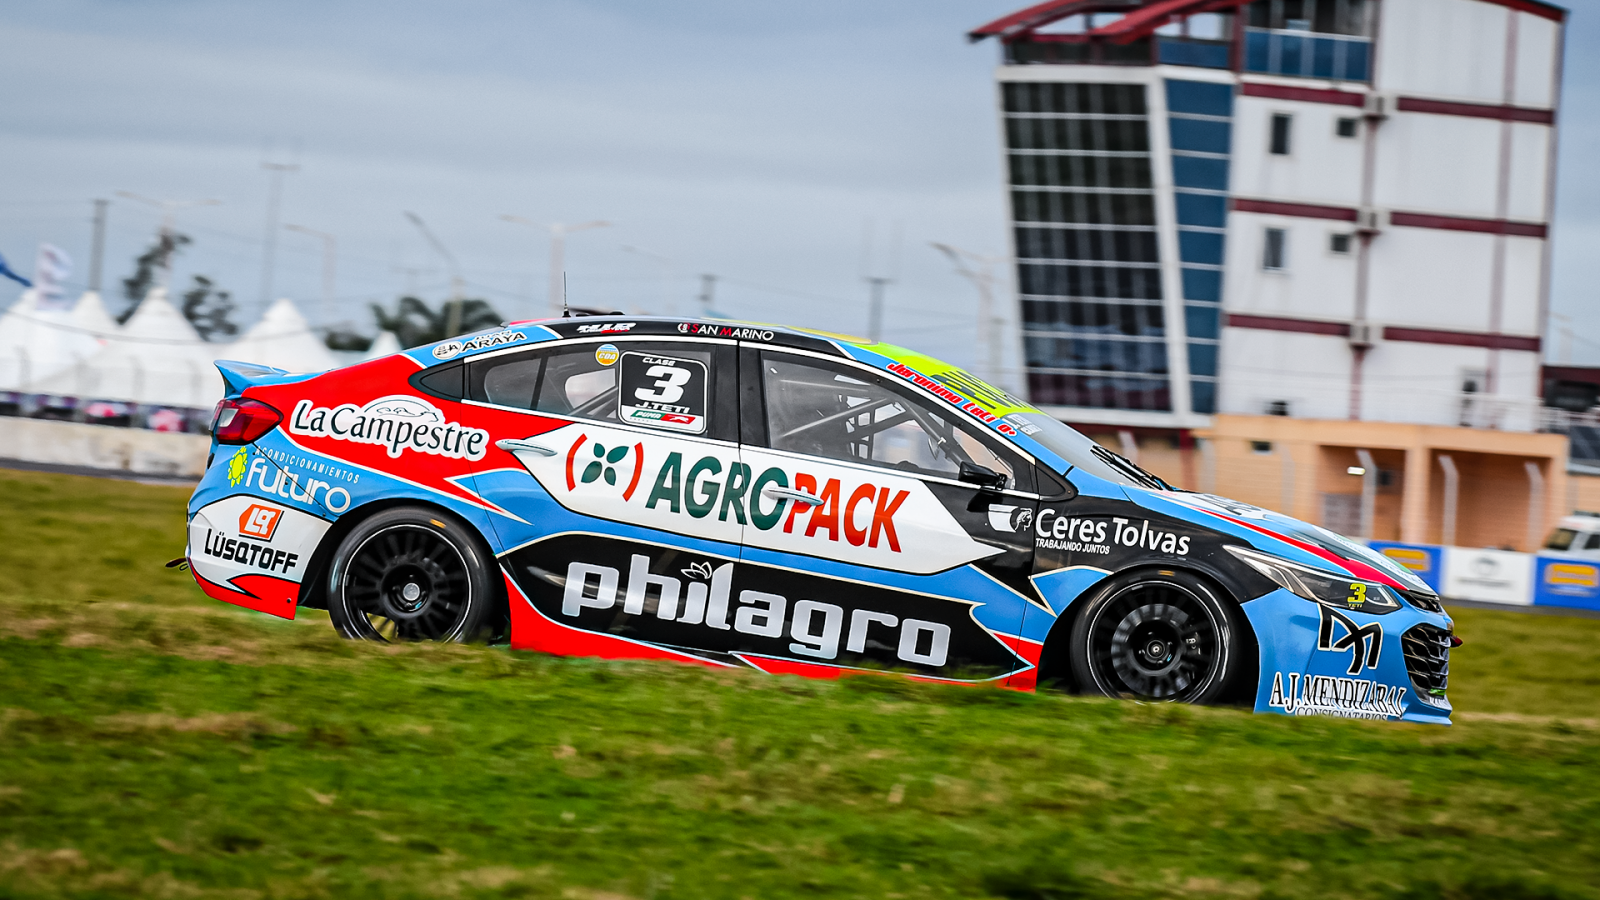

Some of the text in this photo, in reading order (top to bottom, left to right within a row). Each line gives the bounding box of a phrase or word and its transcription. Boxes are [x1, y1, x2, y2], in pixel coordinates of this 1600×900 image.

[461, 332, 527, 352] ARAYA
[691, 323, 775, 342] SAN MARINO
[642, 357, 676, 367] CLASE
[634, 365, 692, 404] 3
[886, 363, 963, 405] Jeronimo
[635, 401, 691, 415] J.TETI
[635, 411, 662, 420] PUMA
[295, 402, 484, 456] La Campestre
[254, 445, 361, 485] ACONDICIONAMIENTOS
[245, 457, 352, 514] futuro
[645, 451, 911, 554] AGROPACK
[204, 528, 299, 575] LÜSQTOFF
[1035, 508, 1191, 556] Ceres Tolvas
[1035, 537, 1111, 555] TRABAJANDO JUNTOS
[561, 553, 952, 667] philagro
[1347, 581, 1367, 603] 3
